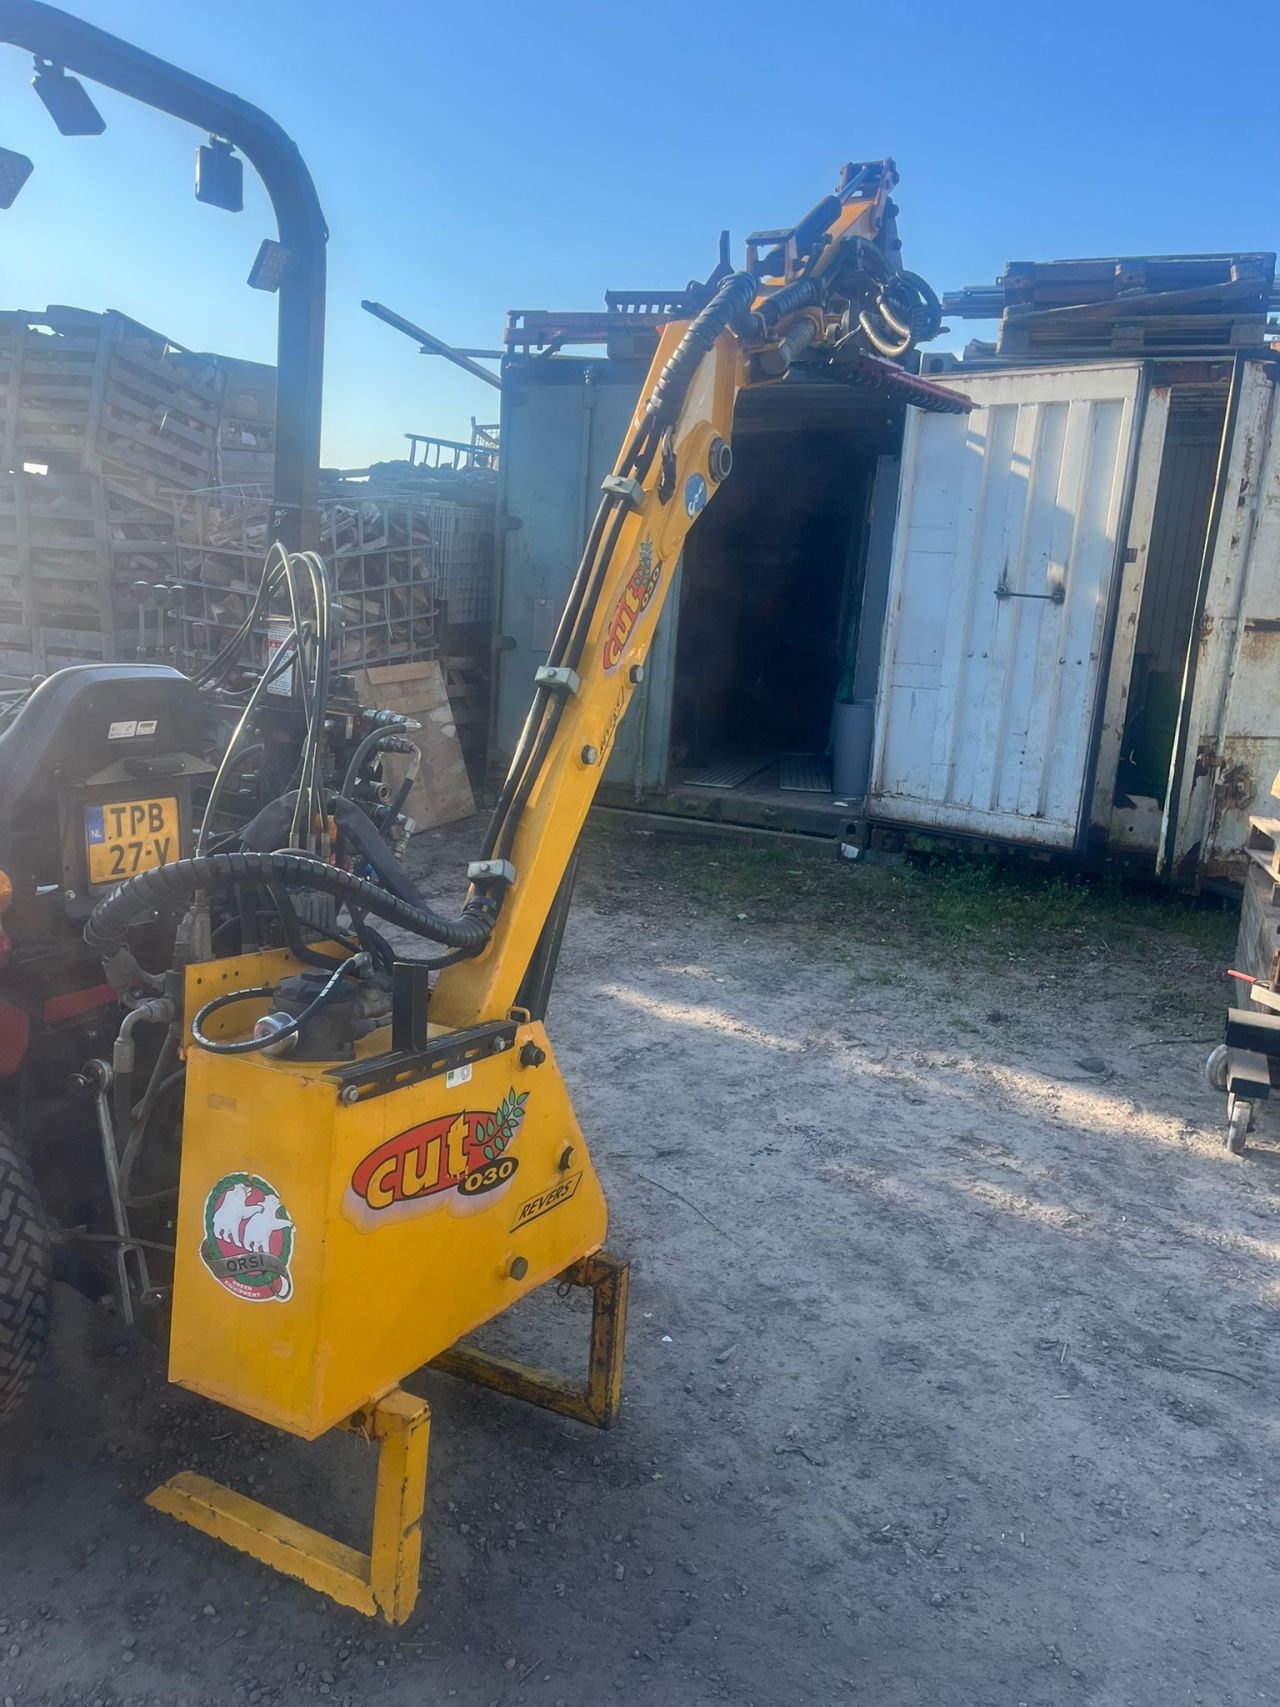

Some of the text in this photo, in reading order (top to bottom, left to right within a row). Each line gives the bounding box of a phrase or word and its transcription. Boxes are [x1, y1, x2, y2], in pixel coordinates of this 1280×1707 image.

[641, 567, 660, 608] 030
[91, 829, 102, 838] NL
[110, 803, 164, 837] TPB
[110, 837, 170, 875] 27-V
[465, 1160, 513, 1191] 030
[518, 1180, 572, 1220] REVERS
[226, 1255, 265, 1272] ORSI
